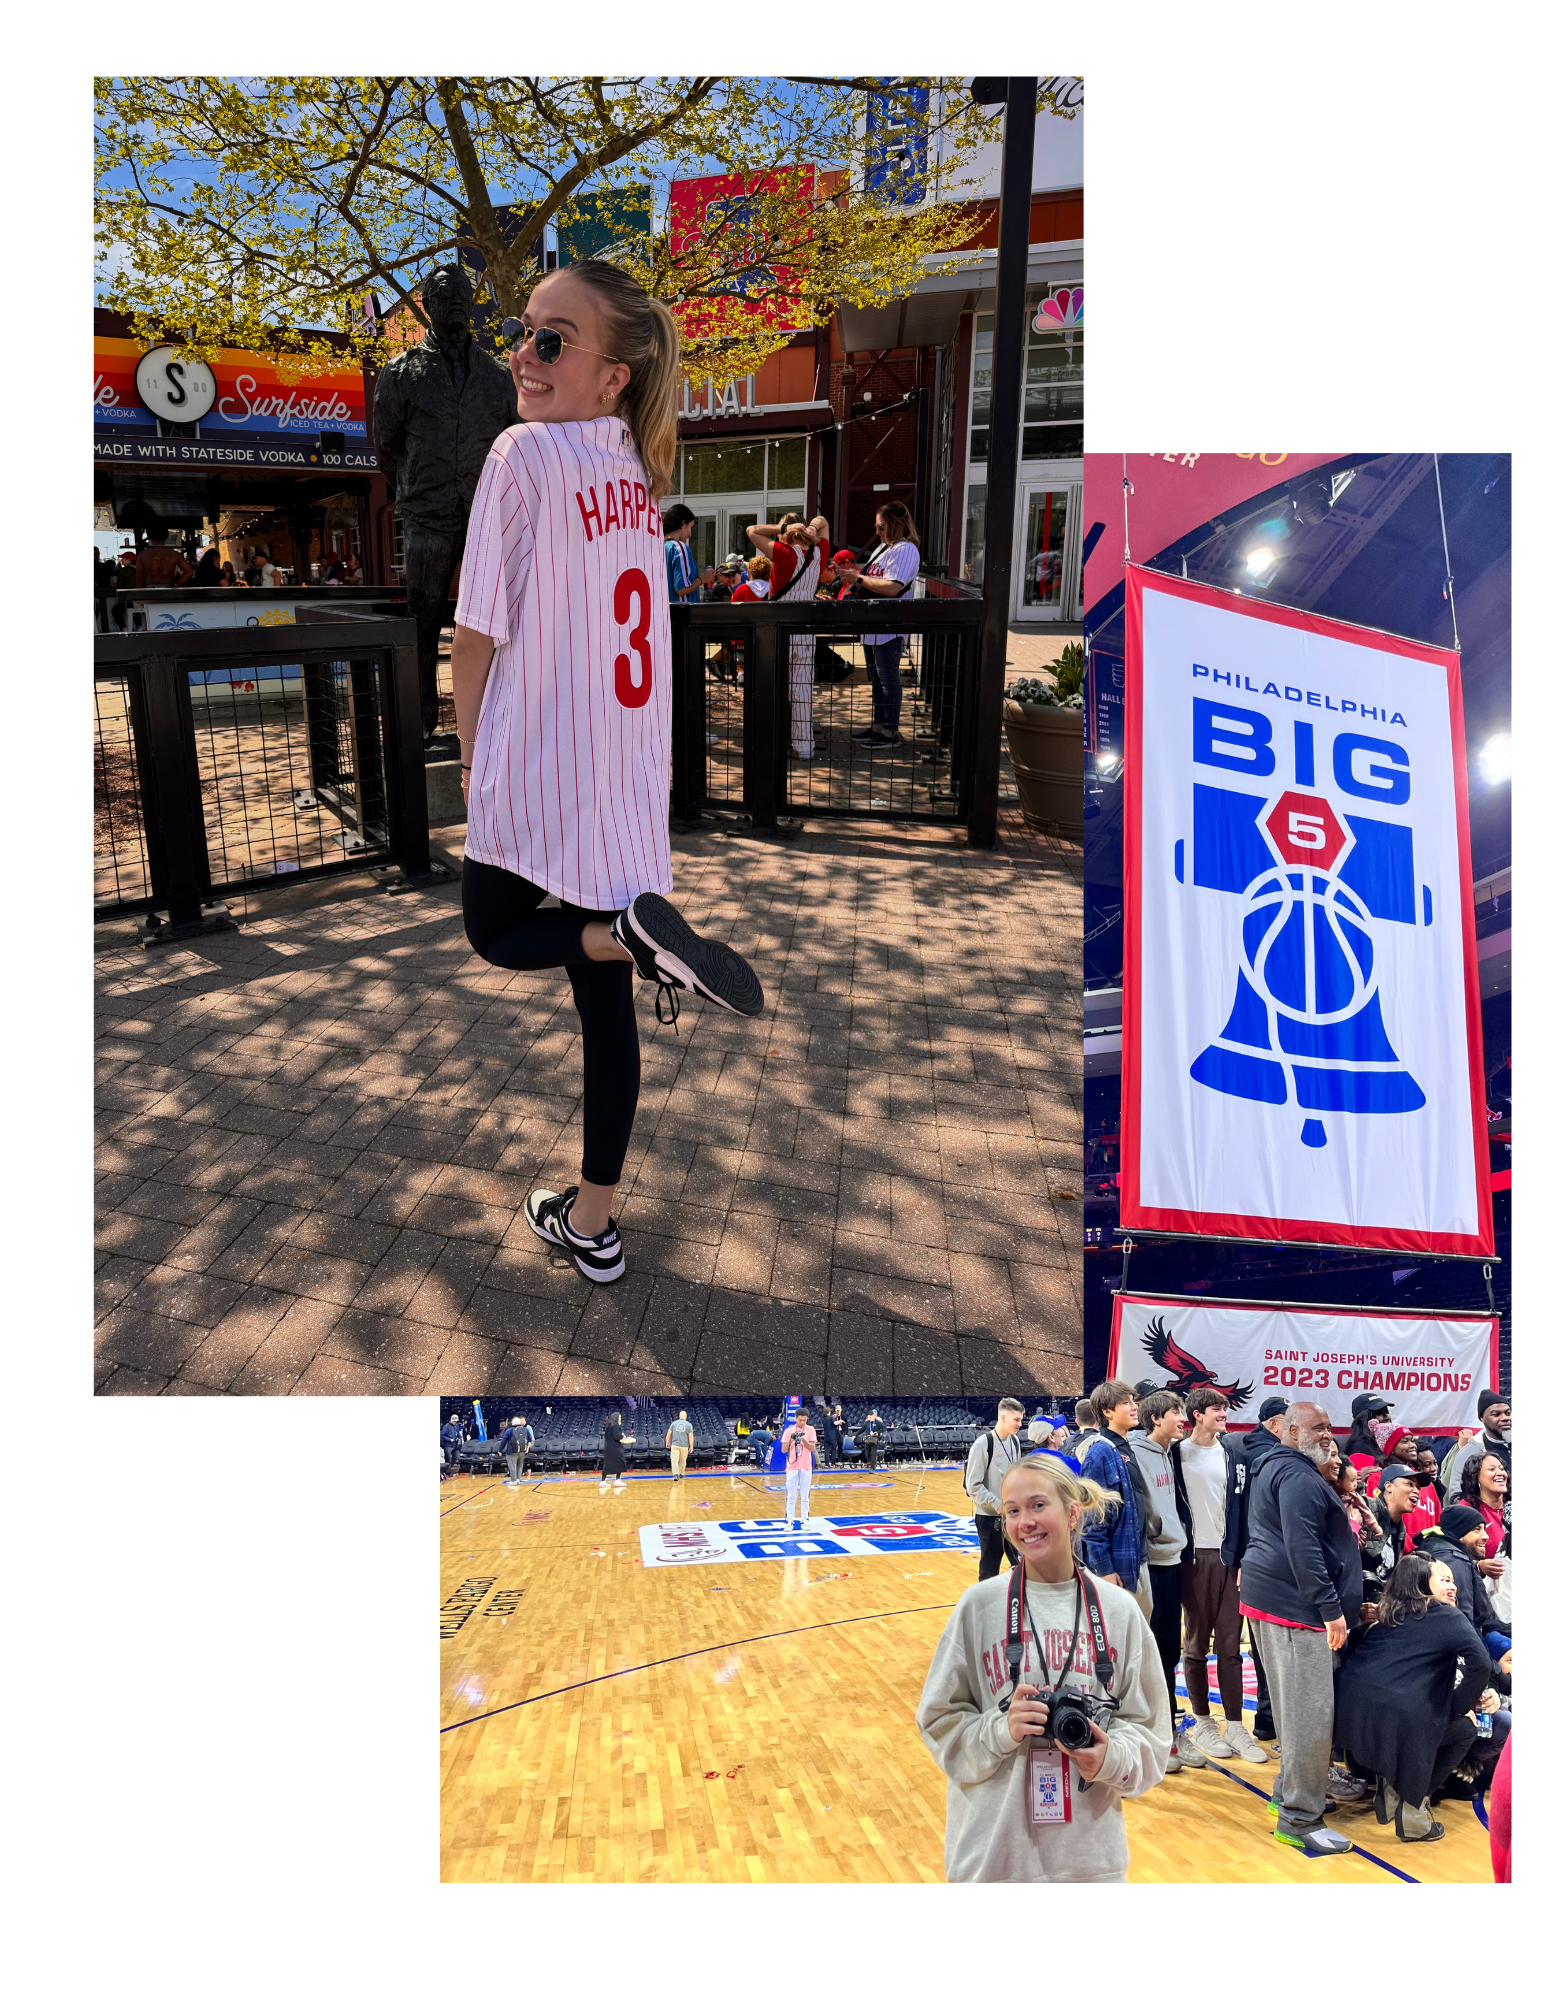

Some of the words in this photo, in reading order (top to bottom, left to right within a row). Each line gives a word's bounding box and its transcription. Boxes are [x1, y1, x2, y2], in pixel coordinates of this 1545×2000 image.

[166, 362, 187, 406] S
[102, 408, 137, 418] VODKA
[218, 374, 351, 428] Surfside
[290, 420, 310, 428] ICED
[337, 423, 364, 431] VODKA
[93, 444, 132, 456] MADE
[138, 445, 176, 457] WITH
[182, 447, 254, 461] STATESIDE
[259, 451, 305, 463] VODKA
[322, 454, 341, 465] 100
[345, 455, 378, 467] CALS
[613, 567, 653, 710] 3
[1101, 693, 1121, 704] HALL
[1193, 663, 1408, 728] PHILADELPHIA
[1193, 696, 1411, 806] BIG
[1287, 811, 1326, 850] 5
[1264, 1349, 1308, 1362] SAINT
[1312, 1352, 1378, 1365] JOSEPH'S
[1382, 1355, 1455, 1368] UNIVERSITY
[1263, 1365, 1330, 1389] 2023
[1337, 1369, 1472, 1392] CHAMPIONS
[719, 1519, 851, 1559] BIG
[857, 1527, 908, 1536] 5
[445, 1576, 499, 1604] FARGO
[482, 1589, 526, 1617] CENTER
[1011, 1598, 1020, 1634] Canon
[1089, 1605, 1100, 1624] 80D
[1093, 1625, 1106, 1652] EOS
